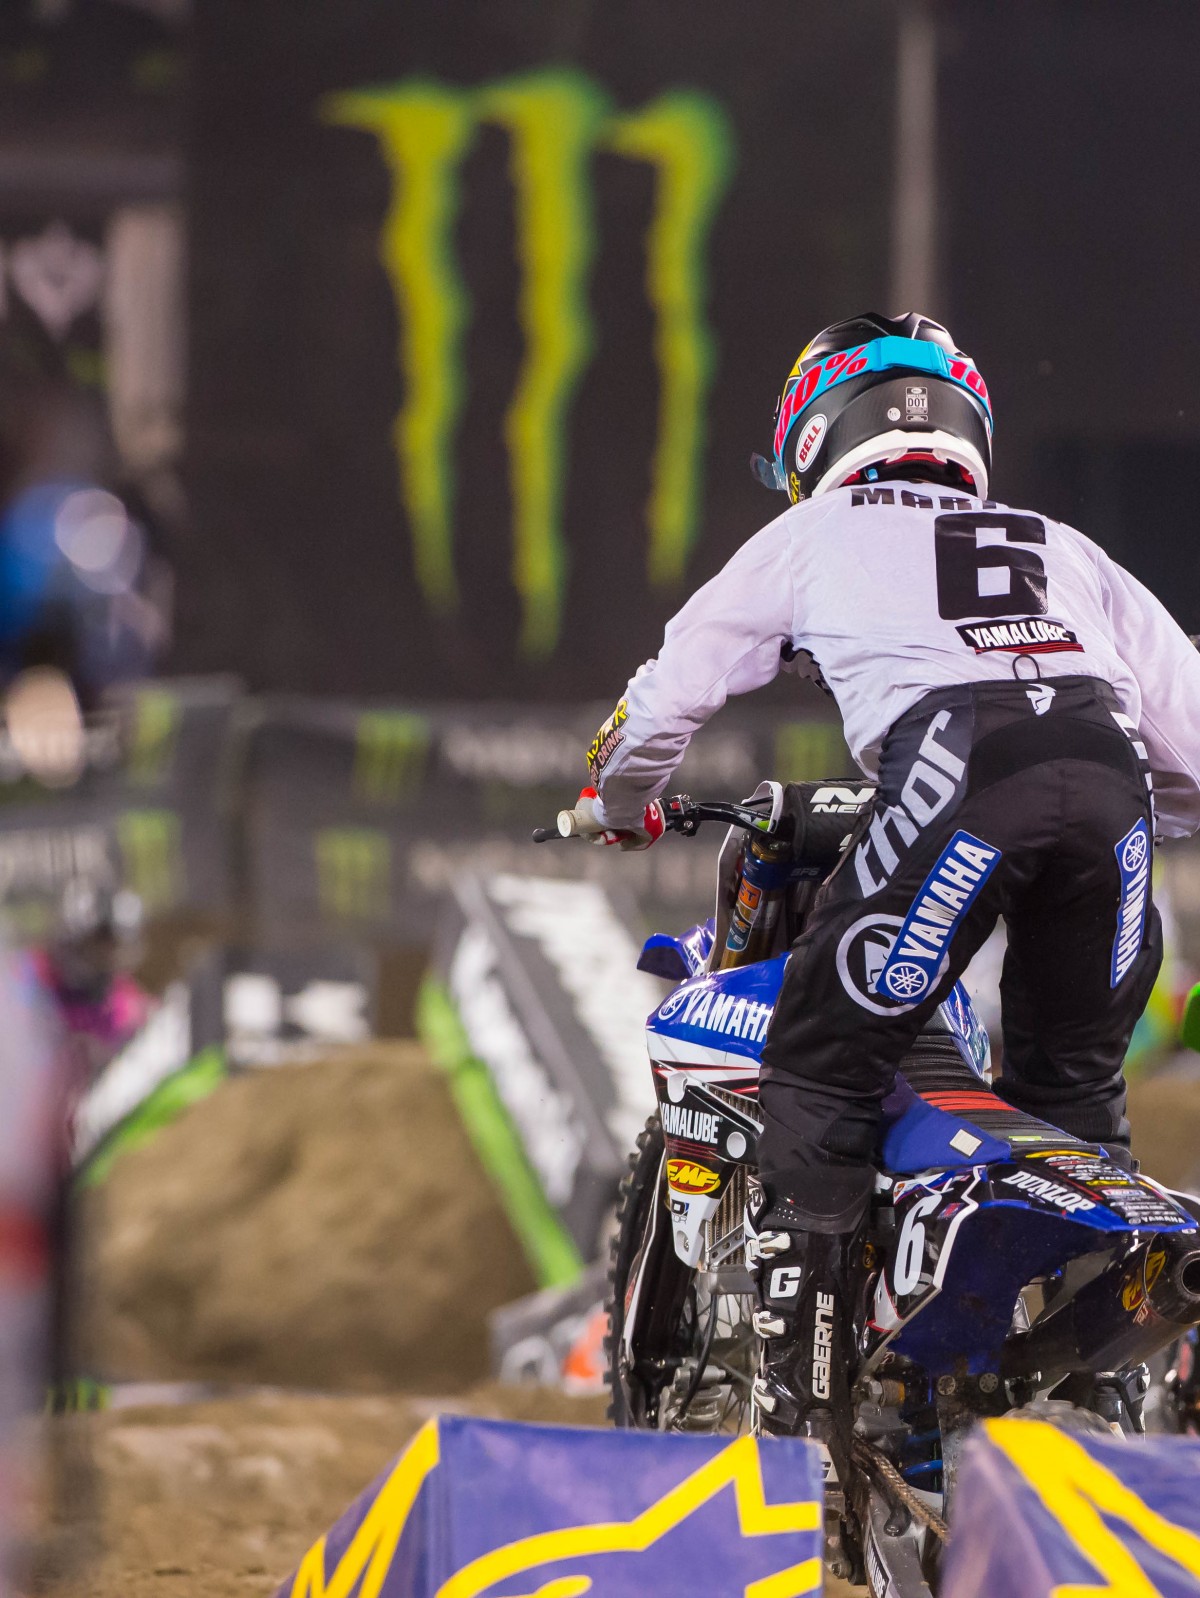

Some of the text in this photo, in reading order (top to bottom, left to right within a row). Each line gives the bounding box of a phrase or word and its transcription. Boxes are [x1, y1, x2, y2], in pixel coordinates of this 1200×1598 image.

[907, 397, 927, 407] DOT
[948, 358, 993, 416] 10
[799, 424, 821, 462] BELL
[934, 512, 1049, 621] 6
[965, 621, 1070, 648] YAMALUBE
[811, 803, 862, 814] NE
[898, 840, 995, 961] YAMAHA
[1001, 1170, 1096, 1213] DUNLOP
[894, 1194, 942, 1296] 6
[812, 1291, 835, 1400] GAERNE
